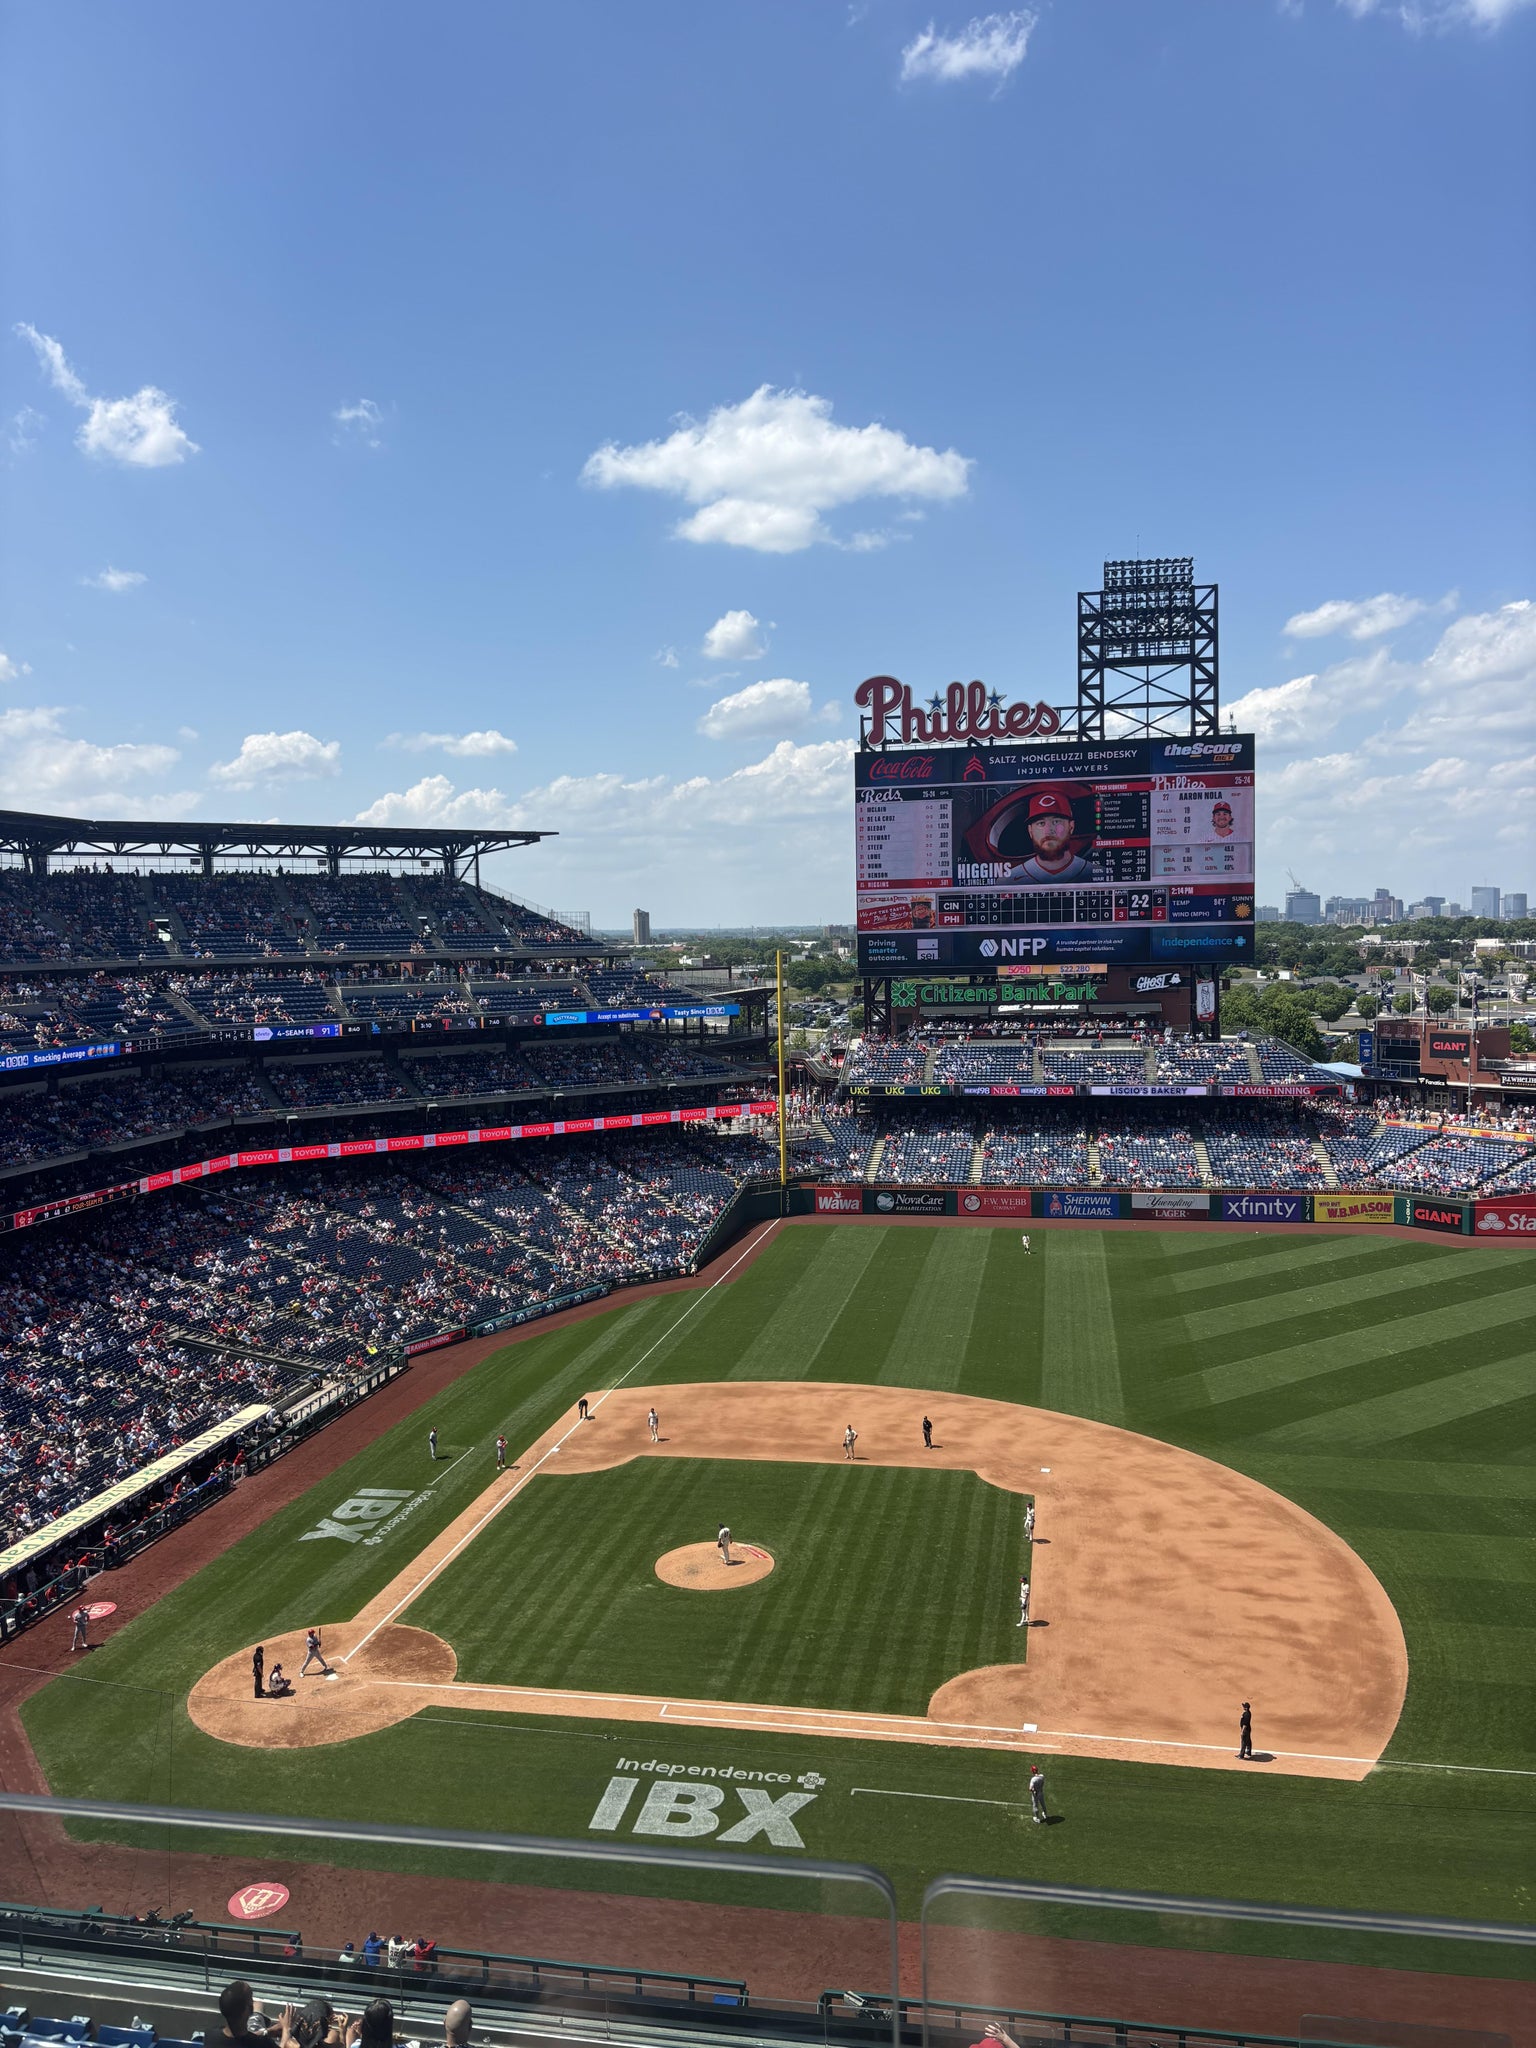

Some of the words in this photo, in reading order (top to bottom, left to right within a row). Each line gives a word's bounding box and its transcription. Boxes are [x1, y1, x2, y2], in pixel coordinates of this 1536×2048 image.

[855, 674, 1061, 745] Phillies
[1164, 743, 1243, 756] theScore
[989, 756, 1017, 764] SALTZ
[1021, 752, 1083, 763] MONGELUZZI
[1088, 750, 1138, 760] BENDESKY
[1017, 767, 1055, 775] INJURY
[1062, 764, 1109, 773] LAWYERS
[1151, 776, 1206, 791] Phillies
[1234, 776, 1251, 785] 25-24
[860, 788, 904, 803] Reds
[1179, 792, 1203, 801] AARON
[1204, 791, 1223, 800] NOLA
[957, 862, 1012, 879] HIGGINS
[1171, 887, 1184, 895] 2:14
[1184, 887, 1194, 895] PM
[943, 902, 960, 911] CIN
[1131, 894, 1150, 908] 2-2
[943, 915, 960, 924] PHI
[1190, 910, 1210, 918] (MPH)
[868, 940, 896, 948] Driving
[1001, 938, 1047, 957] NFP
[1162, 936, 1233, 948] Independence
[1136, 972, 1173, 992] GHOST
[921, 984, 997, 1003] Citizens
[1001, 982, 1051, 1001] Bank
[1054, 980, 1098, 1000] Park
[276, 1029, 304, 1037] 4-SEAM
[1433, 1042, 1466, 1051] GIANT
[6, 1055, 29, 1068] 1914
[34, 1052, 61, 1063] Snacking
[62, 1050, 86, 1060] Average
[849, 1086, 870, 1095] UKG
[885, 1086, 905, 1095] UKG
[920, 1086, 941, 1095] UKG
[992, 1087, 1017, 1095] NECA
[1049, 1087, 1074, 1095] NECA
[1110, 1087, 1149, 1095] LISCIO'S
[1151, 1087, 1188, 1095] BAKERY
[1237, 1086, 1272, 1095] RAV4th
[1273, 1086, 1311, 1095] INNING
[150, 1175, 170, 1186] TOYOTA
[182, 1166, 201, 1178] TOYOTA
[210, 1158, 229, 1170] TOYOTA
[241, 1153, 275, 1162] TOYOTA
[294, 1147, 326, 1157] TOYOTA
[343, 1143, 374, 1152] TOYOTA
[390, 1138, 420, 1148] TOYOTA
[438, 1133, 466, 1143] TOYOTA
[482, 1129, 509, 1139] TOYOTA
[524, 1125, 550, 1134] TOYOTA
[566, 1121, 592, 1130] TOYOTA
[606, 1117, 630, 1126] TOYOTA
[644, 1114, 668, 1122] TOYOTA
[682, 1110, 705, 1118] TOYOTA
[717, 1107, 740, 1115] TOYOTA
[752, 1104, 773, 1112] TOYOTA
[818, 1196, 860, 1211] Wawa
[896, 1194, 945, 1206] NovaCare
[984, 1198, 1000, 1206] F.W.
[1002, 1198, 1027, 1206] WEBB
[1064, 1194, 1111, 1206] SHERWIN
[1146, 1194, 1195, 1207] Yuengling
[1064, 1204, 1113, 1216] WILLIAMS.
[1155, 1209, 1186, 1218] LAGER
[1227, 1197, 1297, 1219] xfinity
[1414, 1208, 1461, 1225] GIANT
[429, 1334, 450, 1348] INNING
[169, 1417, 250, 1459] WELCOME
[78, 1477, 149, 1514] Citizens
[298, 1488, 415, 1544] IBX
[31, 1515, 86, 1542] Bank
[615, 1757, 792, 1784] Independence
[588, 1776, 818, 1849] IBX
